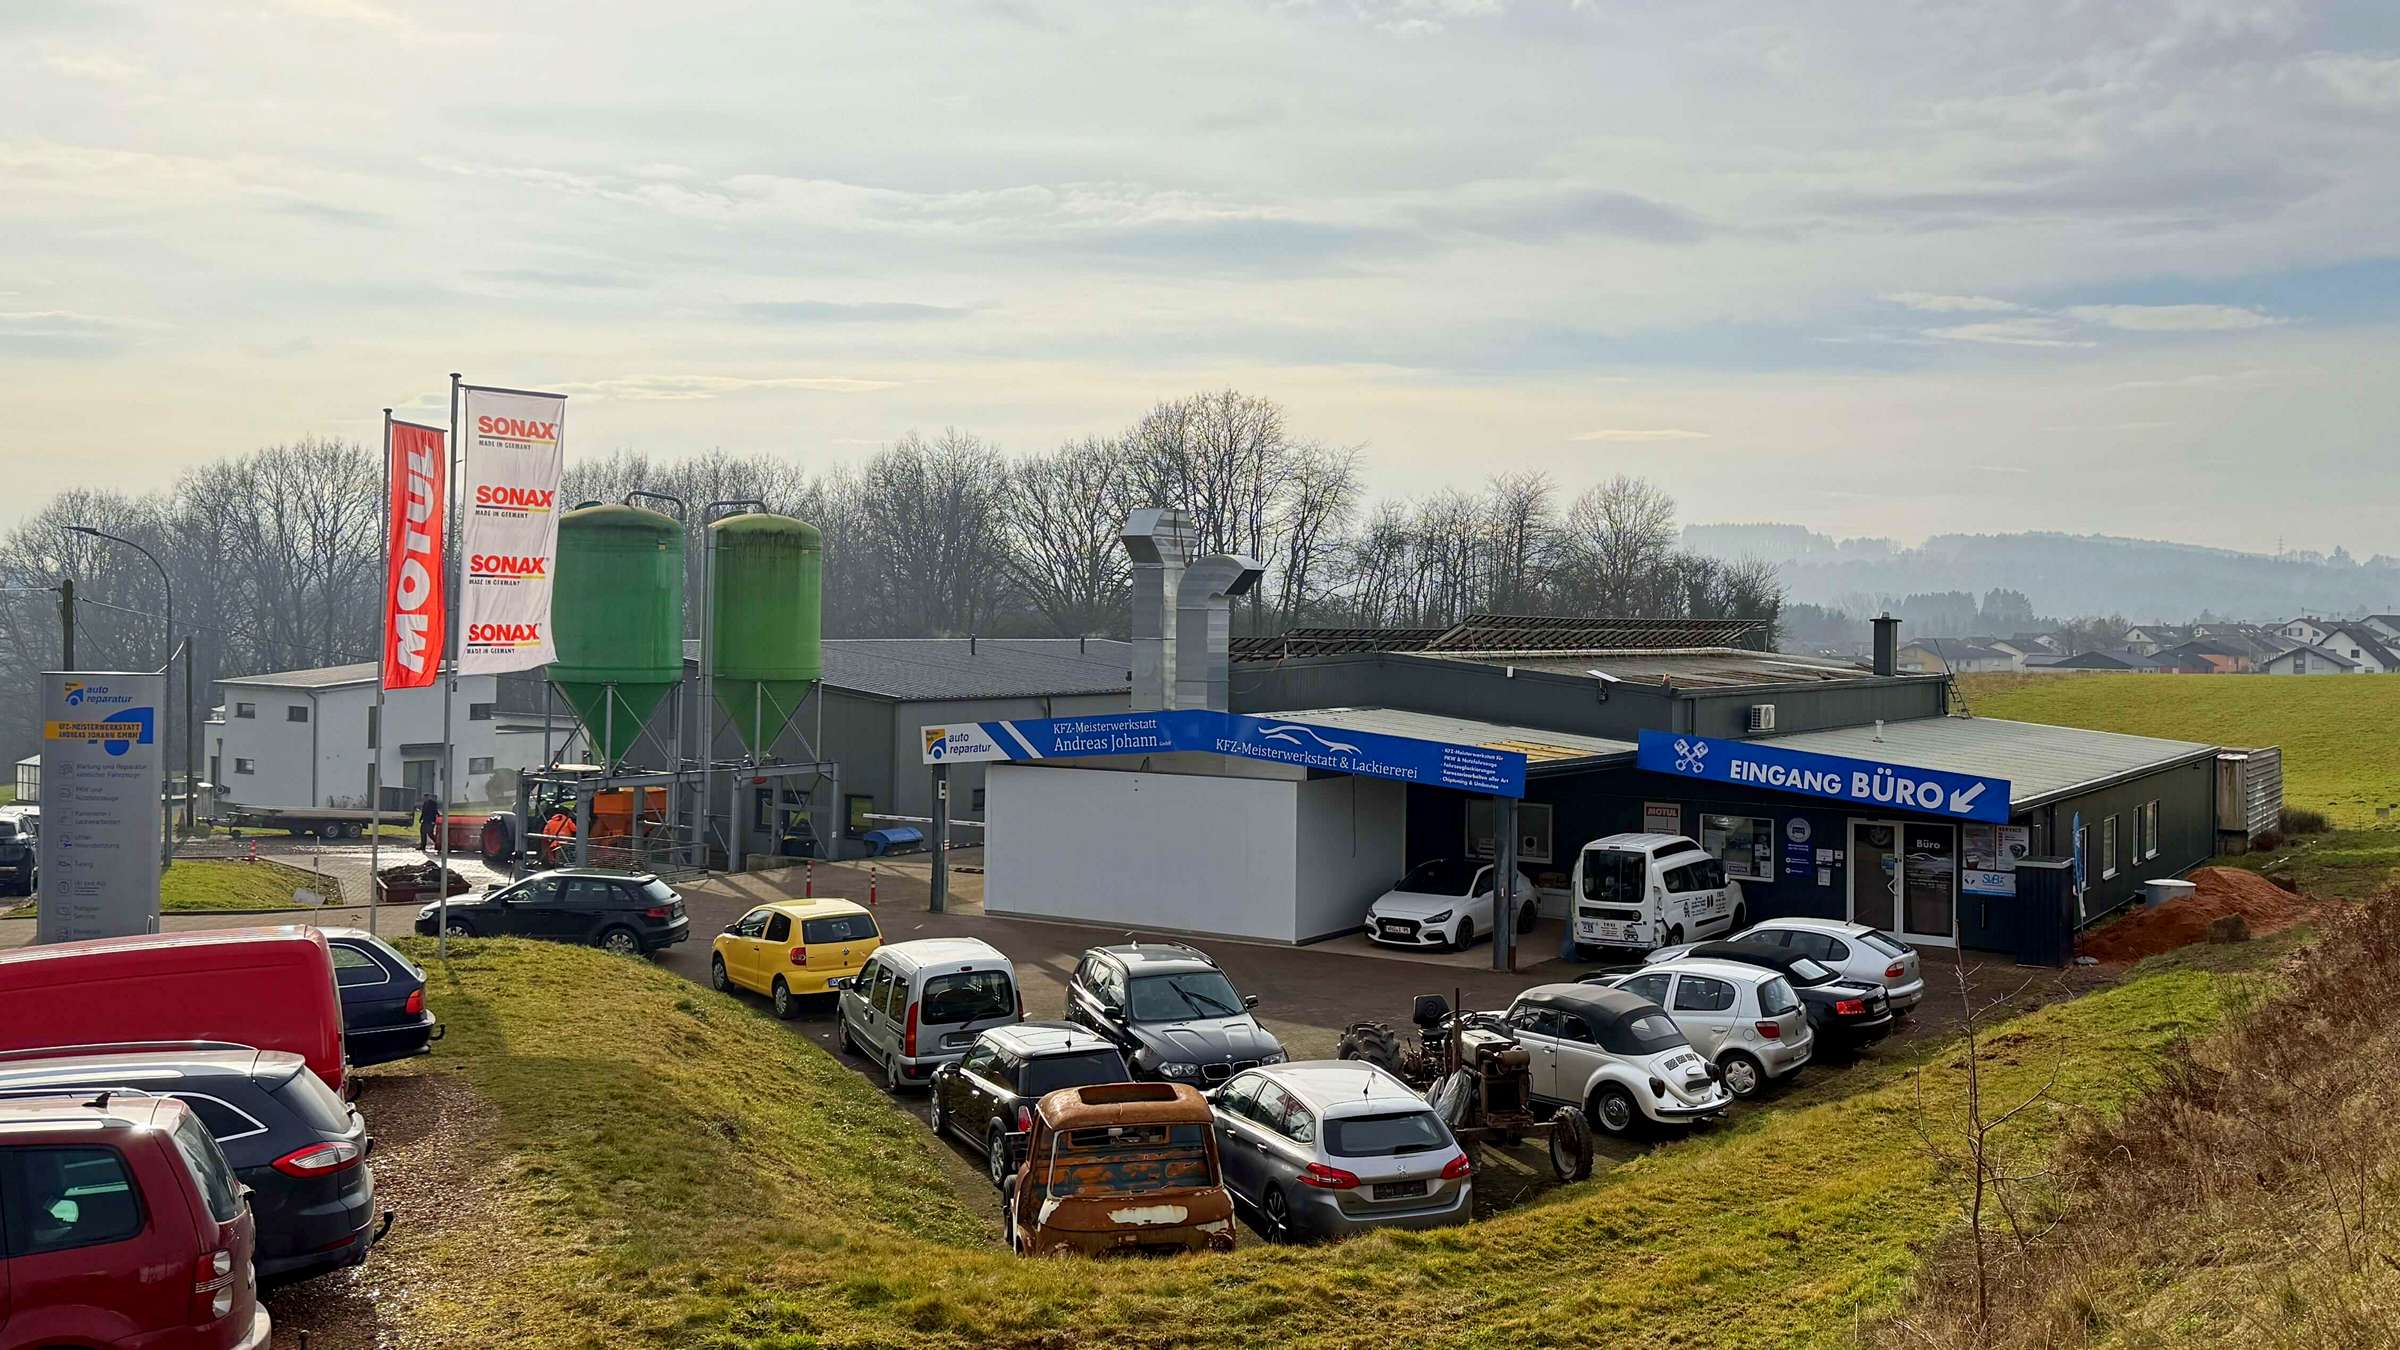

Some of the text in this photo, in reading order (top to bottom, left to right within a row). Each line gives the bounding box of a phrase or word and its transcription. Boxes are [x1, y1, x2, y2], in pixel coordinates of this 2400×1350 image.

[478, 416, 556, 439] SONAX
[505, 442, 531, 450] GERMANY
[476, 485, 554, 507] SONAX
[501, 511, 528, 519] GERMANY
[395, 445, 435, 673] MOTUL
[470, 554, 545, 574] SONAX
[468, 623, 540, 641] SONAX
[86, 686, 109, 694] auto
[86, 695, 133, 704] reparatur
[1053, 719, 1157, 734] KFZ-Meisterwerkstatt
[948, 732, 970, 742] auto
[1054, 736, 1108, 751] Andreas
[1111, 733, 1157, 752] Johann
[949, 744, 992, 756] reparatur
[1216, 738, 1418, 779] KFZ-Meisterwerkstatt & Lackiererei
[1730, 760, 1944, 809] EINGANG BÜRO
[1647, 807, 1678, 817] MOTUL
[1916, 839, 1941, 849] Büro
